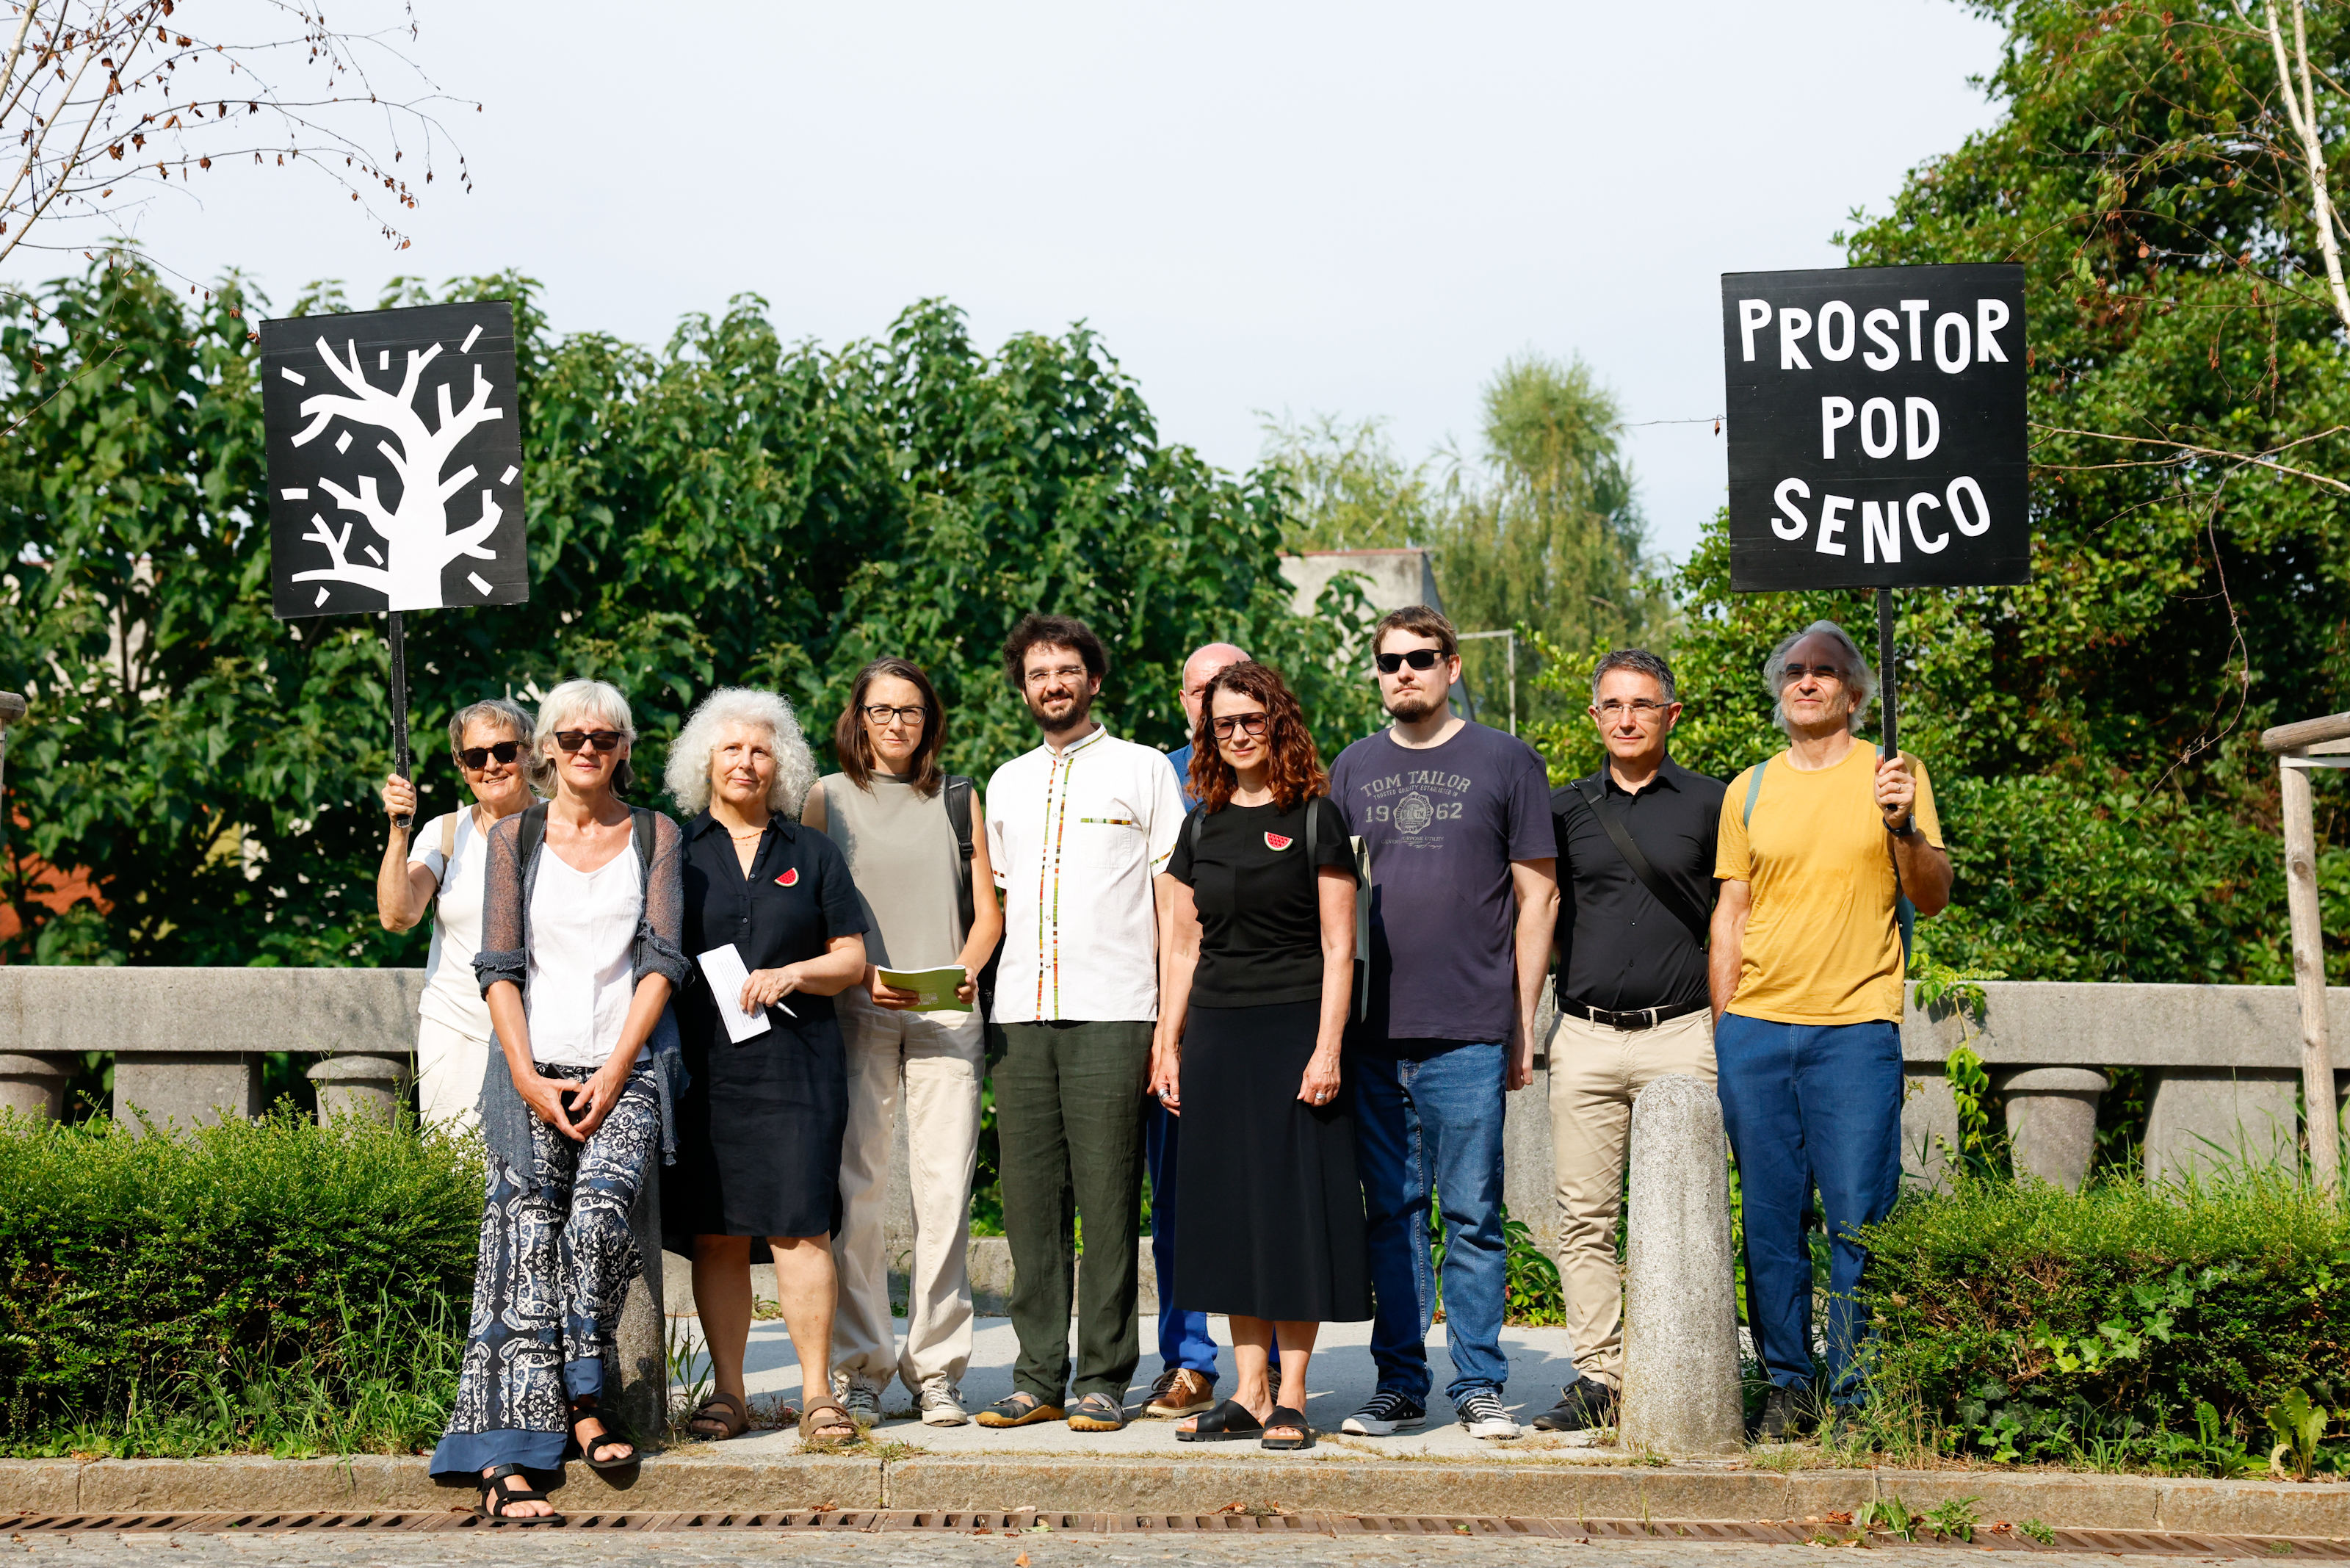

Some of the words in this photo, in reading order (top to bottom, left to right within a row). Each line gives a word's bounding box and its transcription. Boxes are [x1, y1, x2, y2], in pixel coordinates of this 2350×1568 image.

[1738, 298, 2010, 375] PROSTOR
[1821, 396, 1940, 460] POD
[1771, 475, 1991, 564] SENCO
[1360, 773, 1402, 797] TOM
[1407, 770, 1471, 793] TAILOR
[1373, 789, 1396, 801] TRUSTED
[1398, 784, 1419, 794] QUALITY
[1420, 784, 1451, 795] ESTABLISHED
[1365, 805, 1389, 823] 19
[1436, 802, 1463, 820] 62
